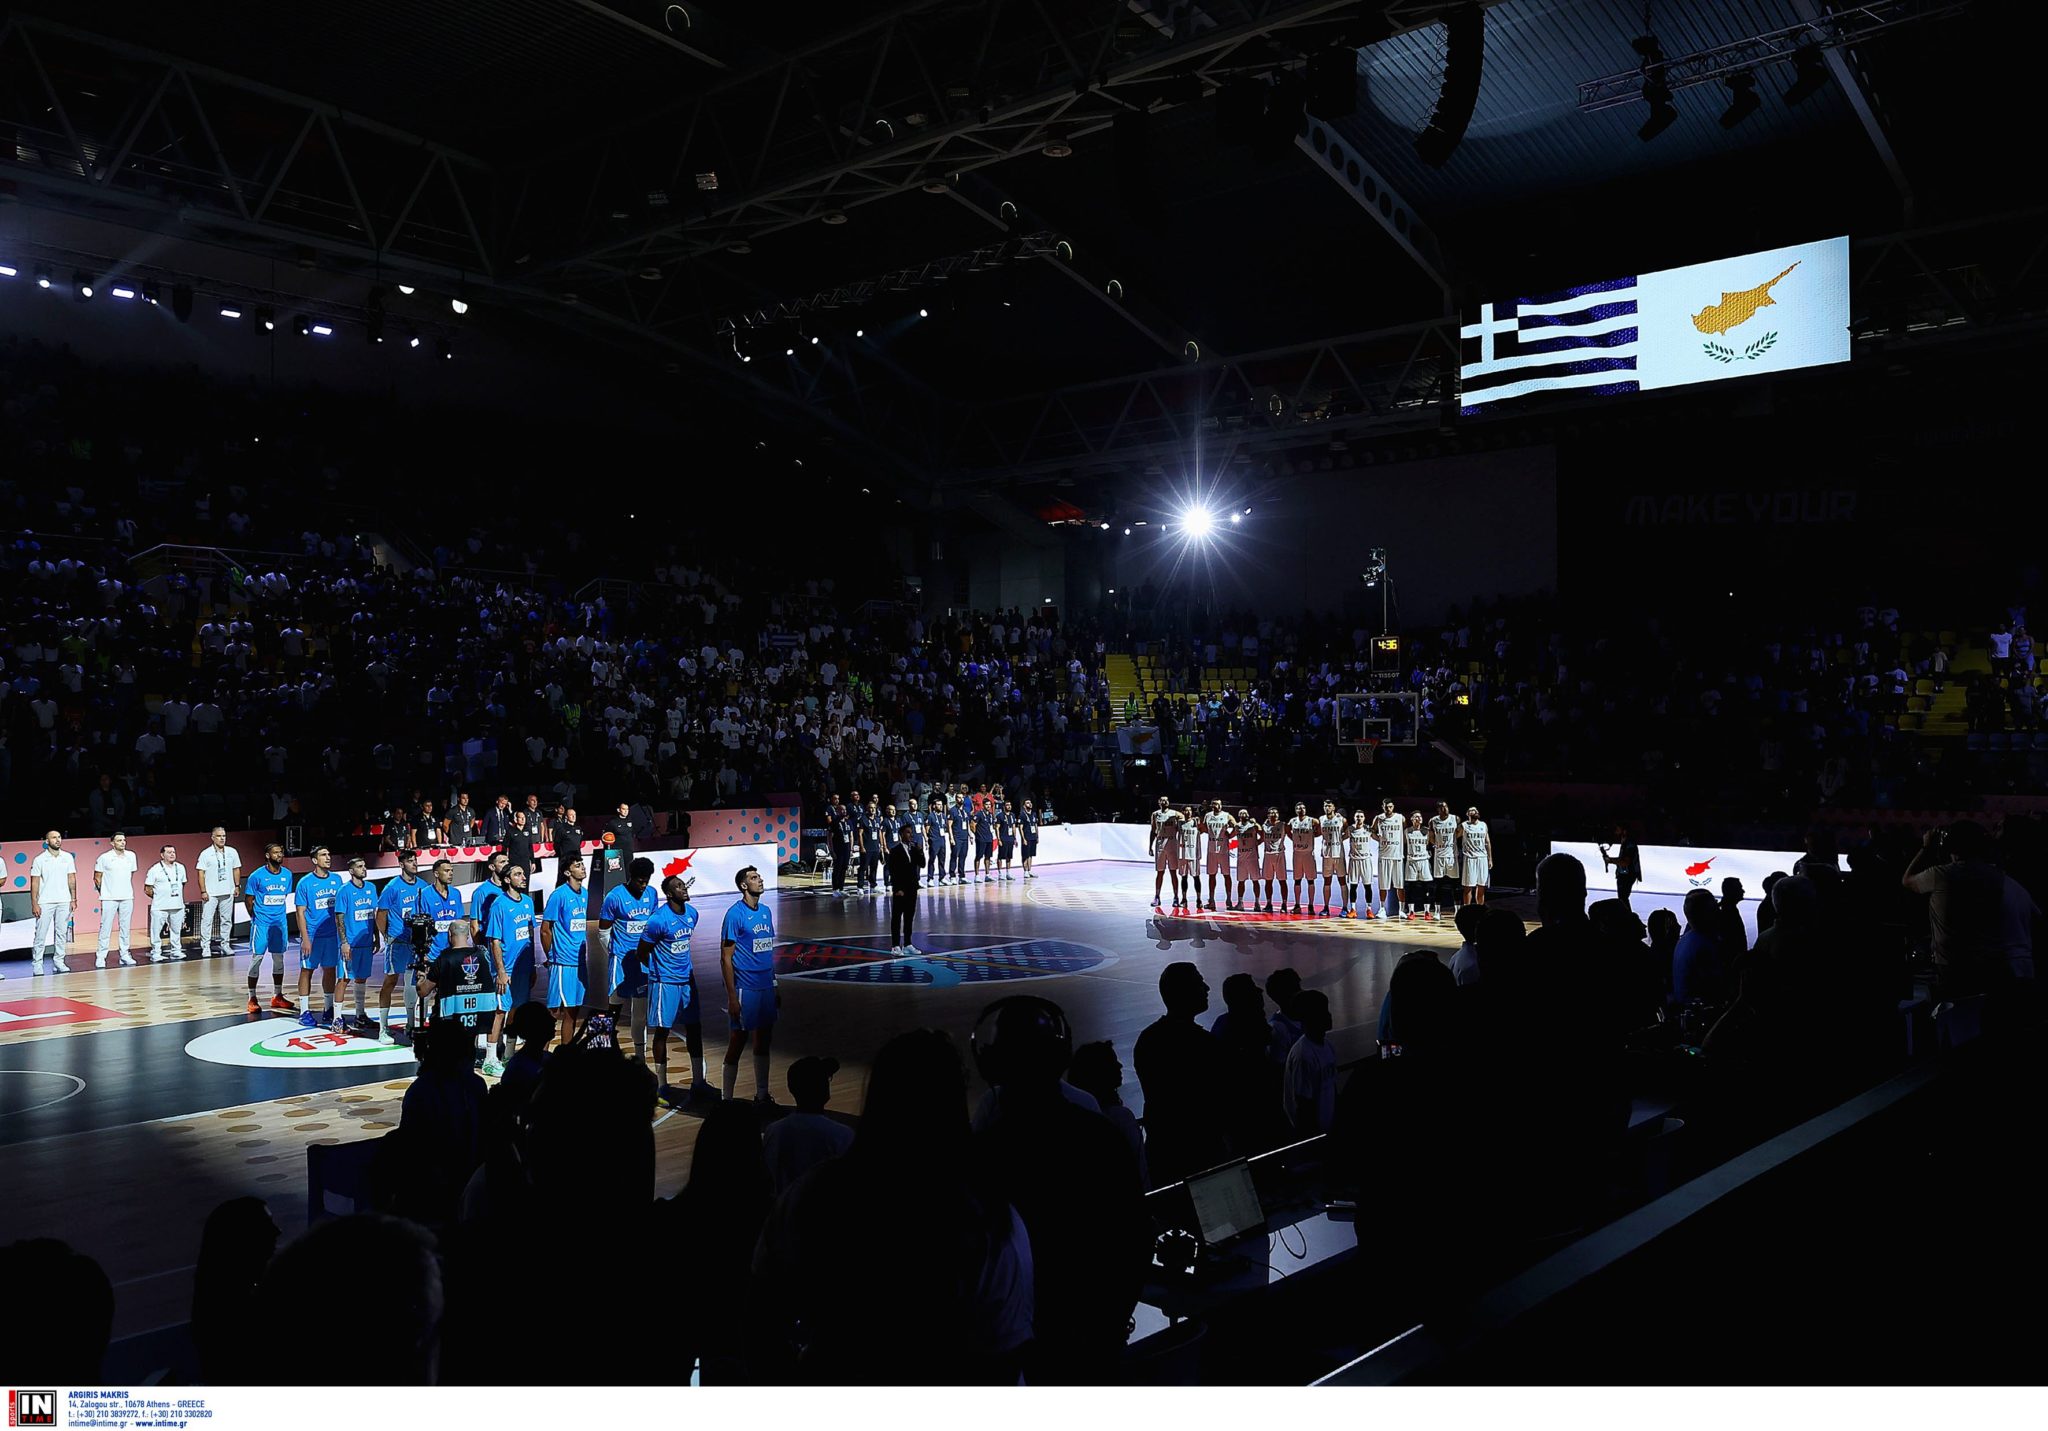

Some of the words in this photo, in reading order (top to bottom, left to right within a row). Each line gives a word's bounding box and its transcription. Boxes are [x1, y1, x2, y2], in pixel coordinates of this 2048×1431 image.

[1623, 493, 1738, 525] MAKE
[1744, 490, 1858, 524] YOUR
[627, 907, 650, 919] HELLAS
[463, 997, 477, 1009] HB
